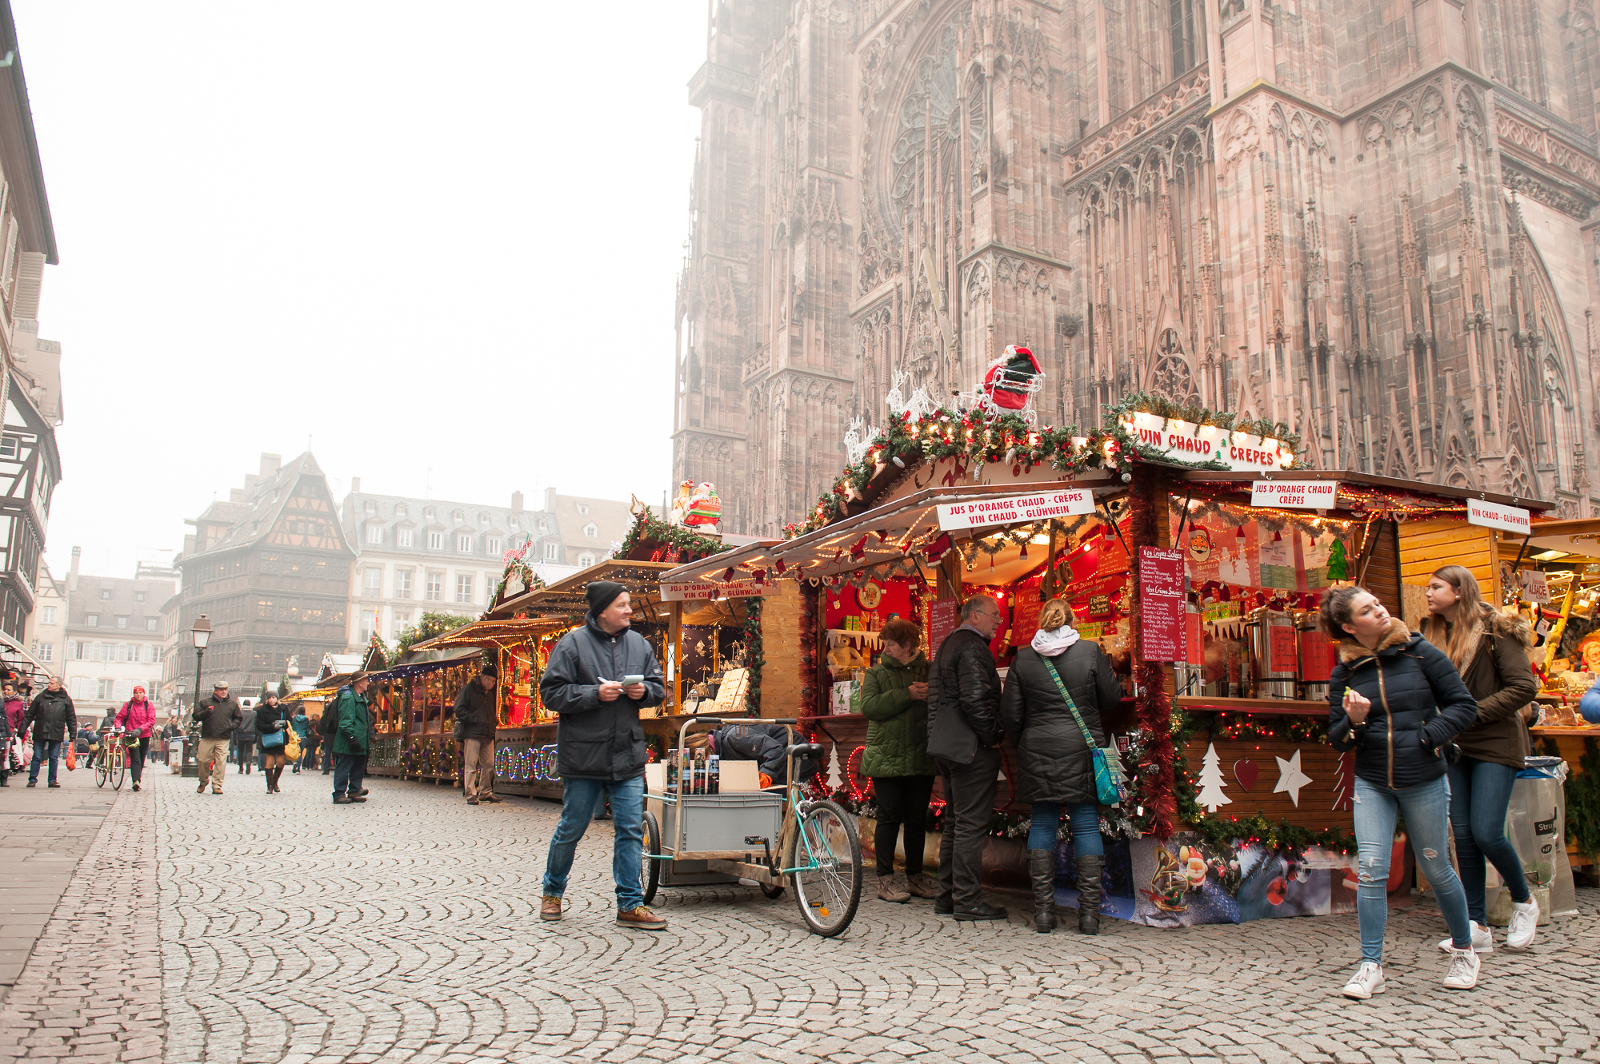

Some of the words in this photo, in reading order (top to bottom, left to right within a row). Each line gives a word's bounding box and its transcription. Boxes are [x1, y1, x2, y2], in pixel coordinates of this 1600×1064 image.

[1139, 428, 1162, 446] VIN
[1168, 434, 1211, 454] CHAUD
[1230, 446, 1274, 466] CREPES
[1255, 484, 1267, 493] JUS
[1269, 484, 1306, 494] D'ORANGE
[1307, 485, 1333, 494] CHAUD
[950, 505, 966, 516] JUS
[968, 500, 1014, 513] D'ORANGE
[1017, 497, 1045, 508] CHAUD
[1053, 492, 1083, 504] CRÊPES
[1279, 494, 1304, 504] CRÊPES
[969, 515, 985, 525] VIN
[988, 512, 1018, 522] CHAUD
[1026, 505, 1070, 518] GLÜHWEIN
[1471, 508, 1481, 517] VIN
[1482, 510, 1499, 521] CHAUD
[1503, 513, 1529, 526] GLÜHWEIN
[683, 583, 720, 592] D'ORAN
